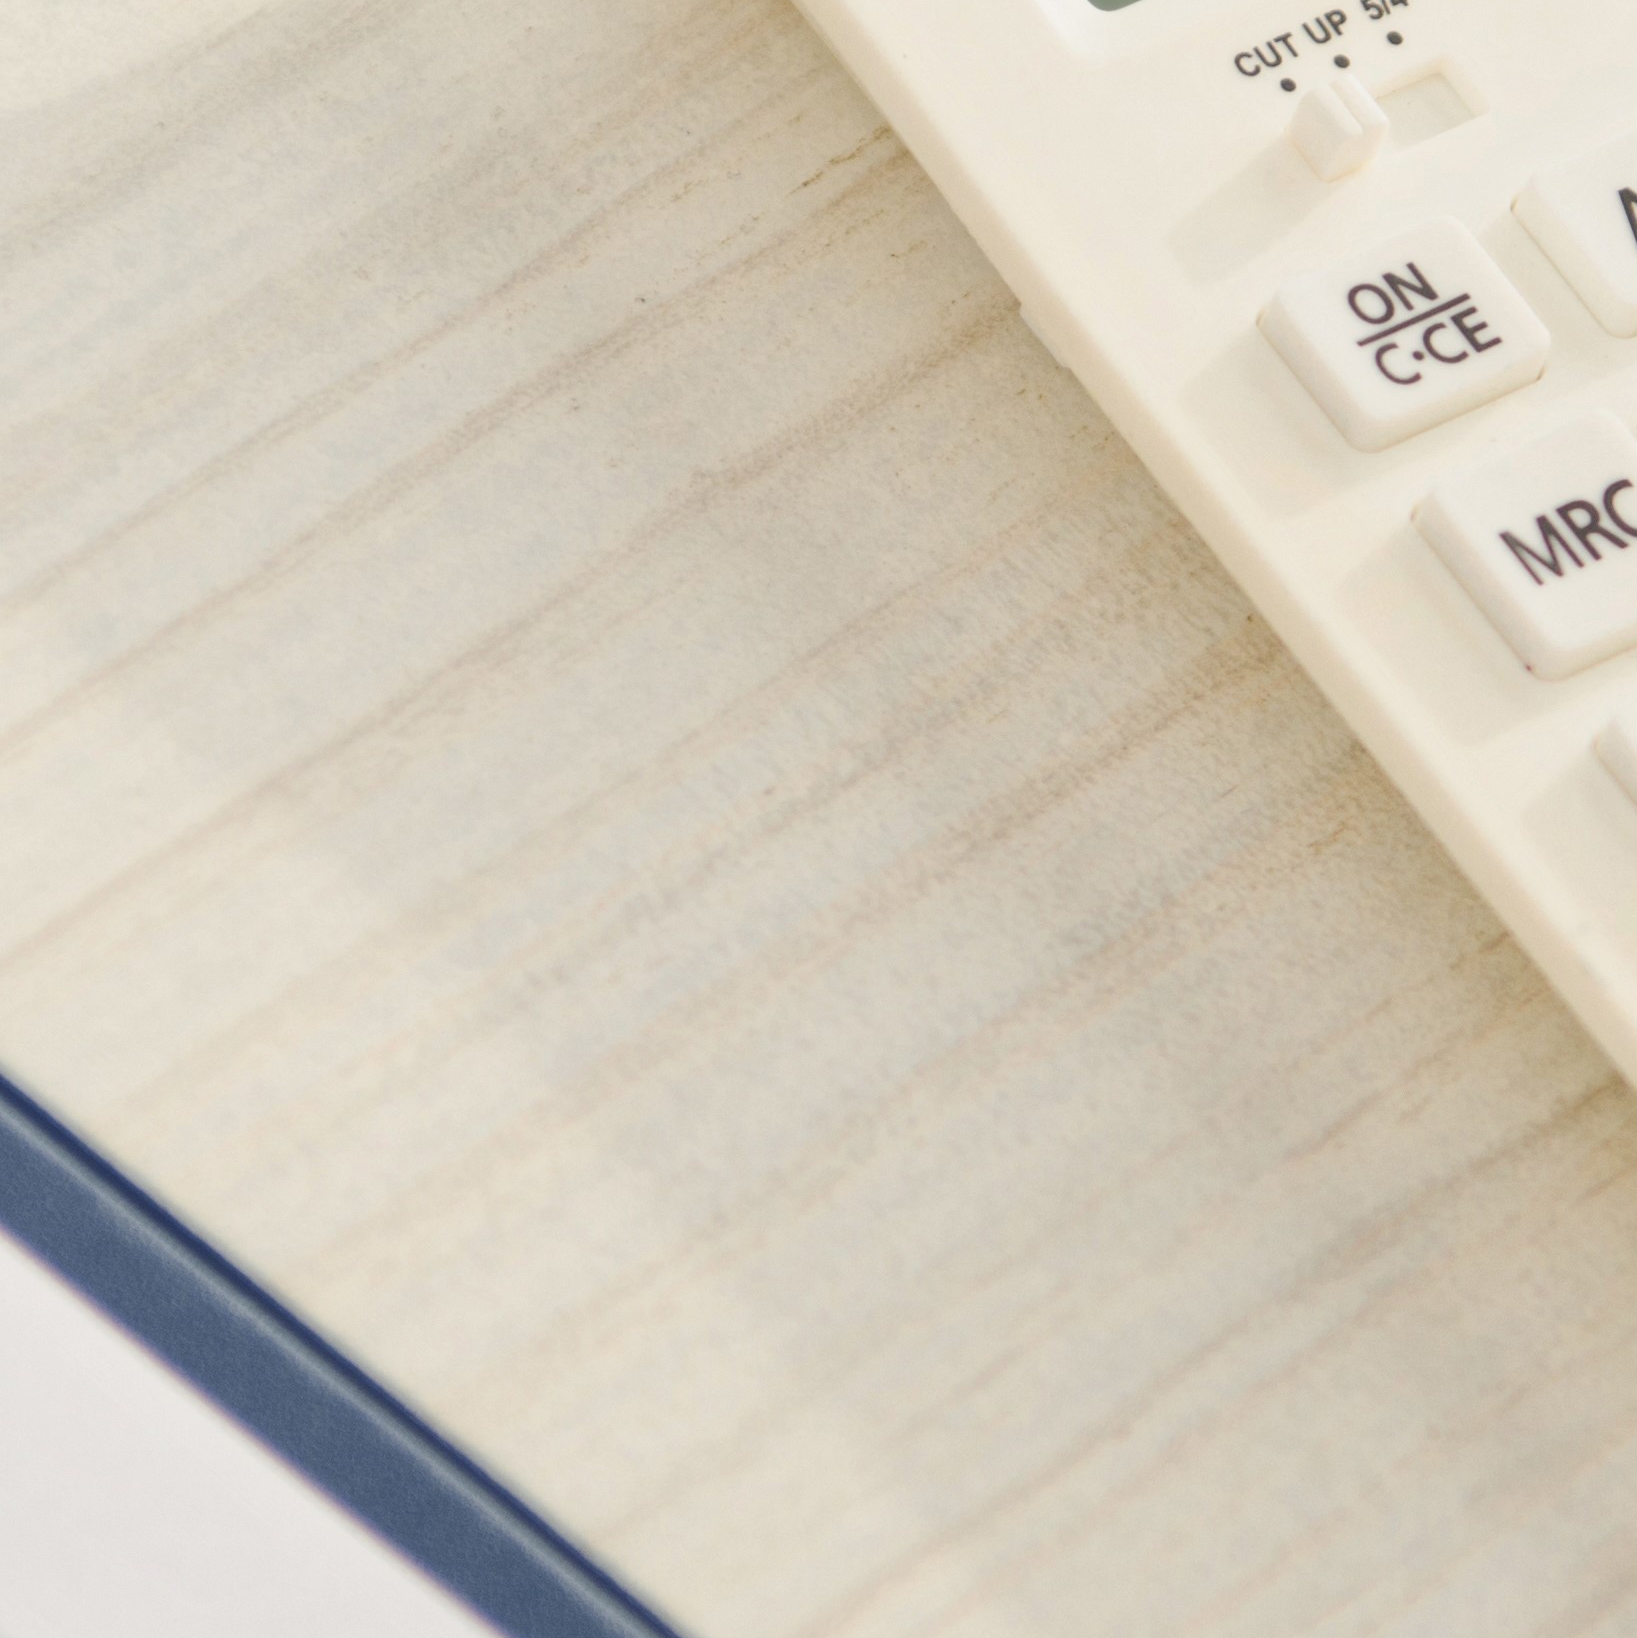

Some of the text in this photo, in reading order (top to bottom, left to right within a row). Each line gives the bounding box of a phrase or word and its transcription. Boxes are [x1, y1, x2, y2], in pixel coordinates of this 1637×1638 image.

[1233, 32, 1299, 78] CUT
[1301, 9, 1348, 45] UP
[1346, 261, 1439, 325] ON
